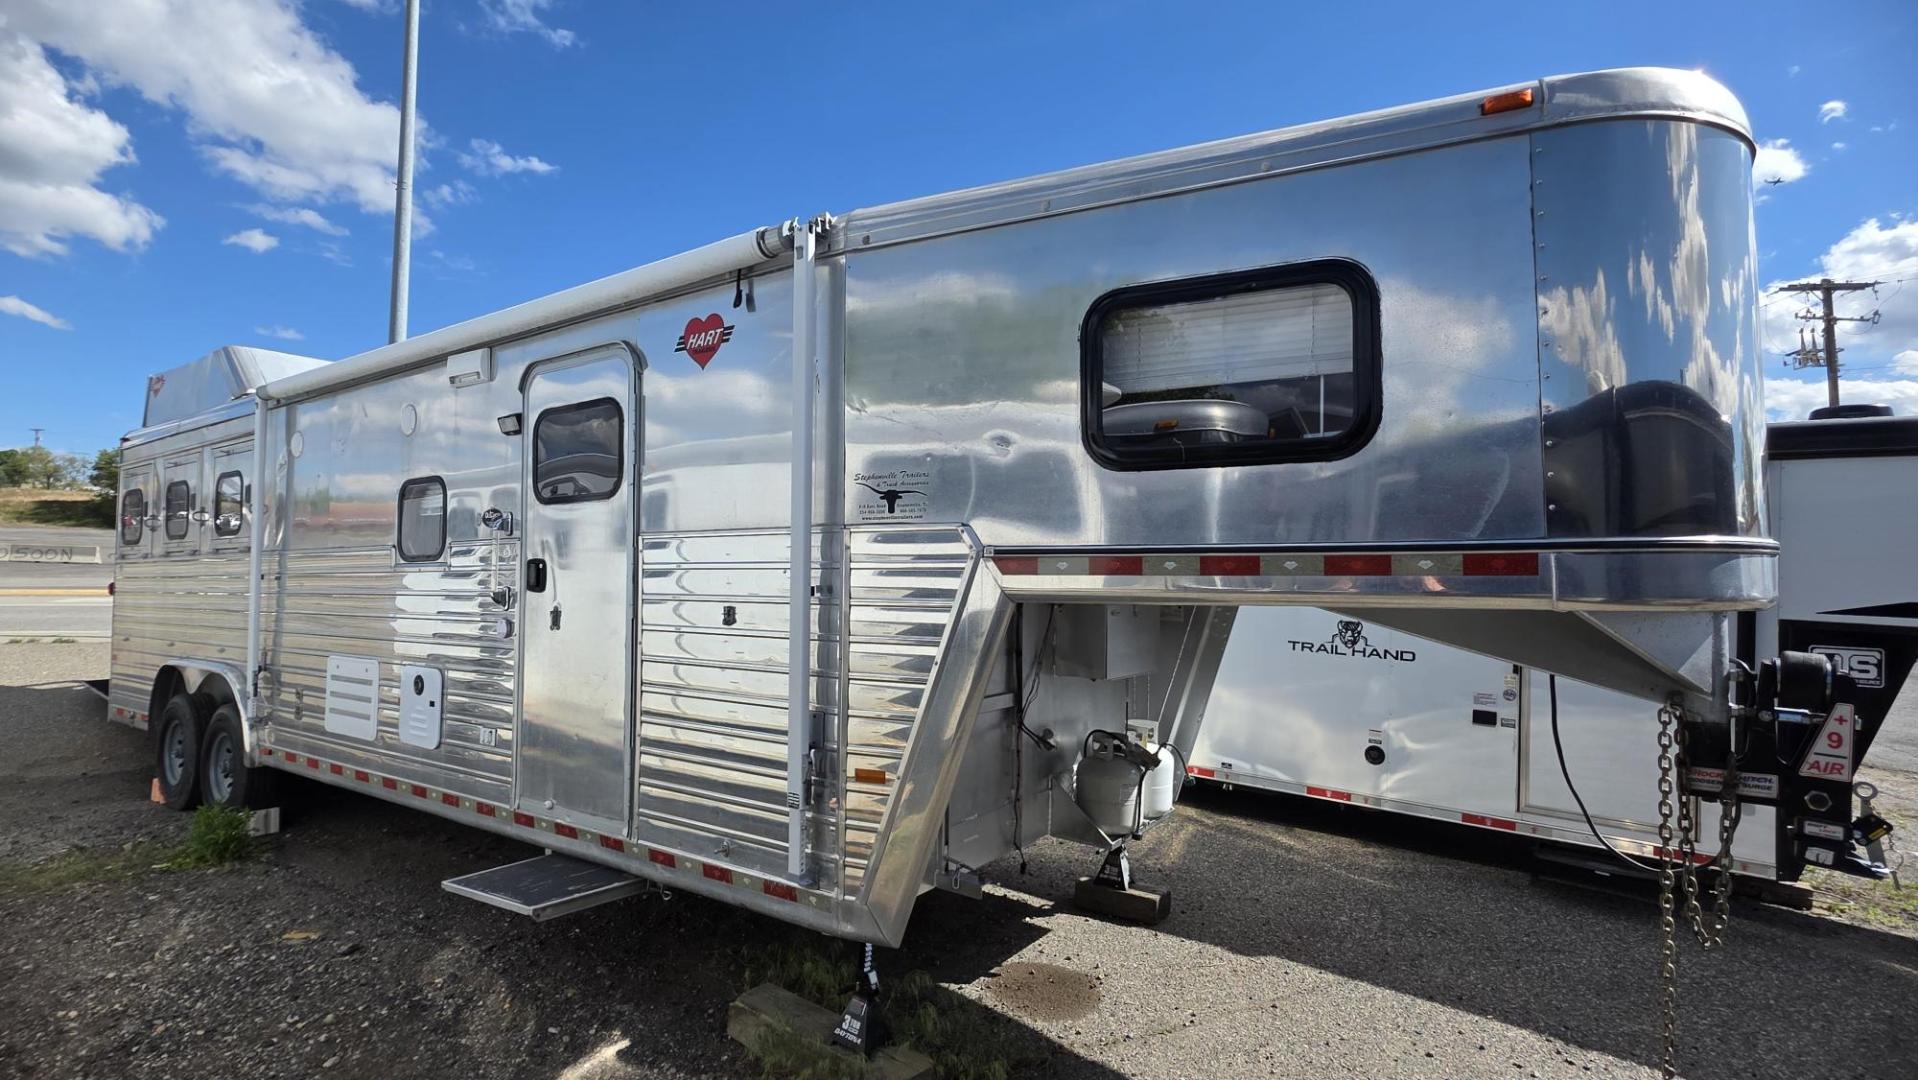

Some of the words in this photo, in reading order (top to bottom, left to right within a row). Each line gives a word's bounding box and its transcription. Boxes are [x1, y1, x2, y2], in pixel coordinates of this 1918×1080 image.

[687, 328, 724, 350] HART
[854, 472, 897, 482] Stephenville
[899, 470, 929, 479] Trailers
[15, 547, 73, 561] SOON
[1287, 640, 1347, 656] TRAIL
[1351, 647, 1416, 662] HAND
[1827, 731, 1844, 750] 9
[1807, 760, 1845, 776] AIR
[841, 1014, 851, 1030] 3
